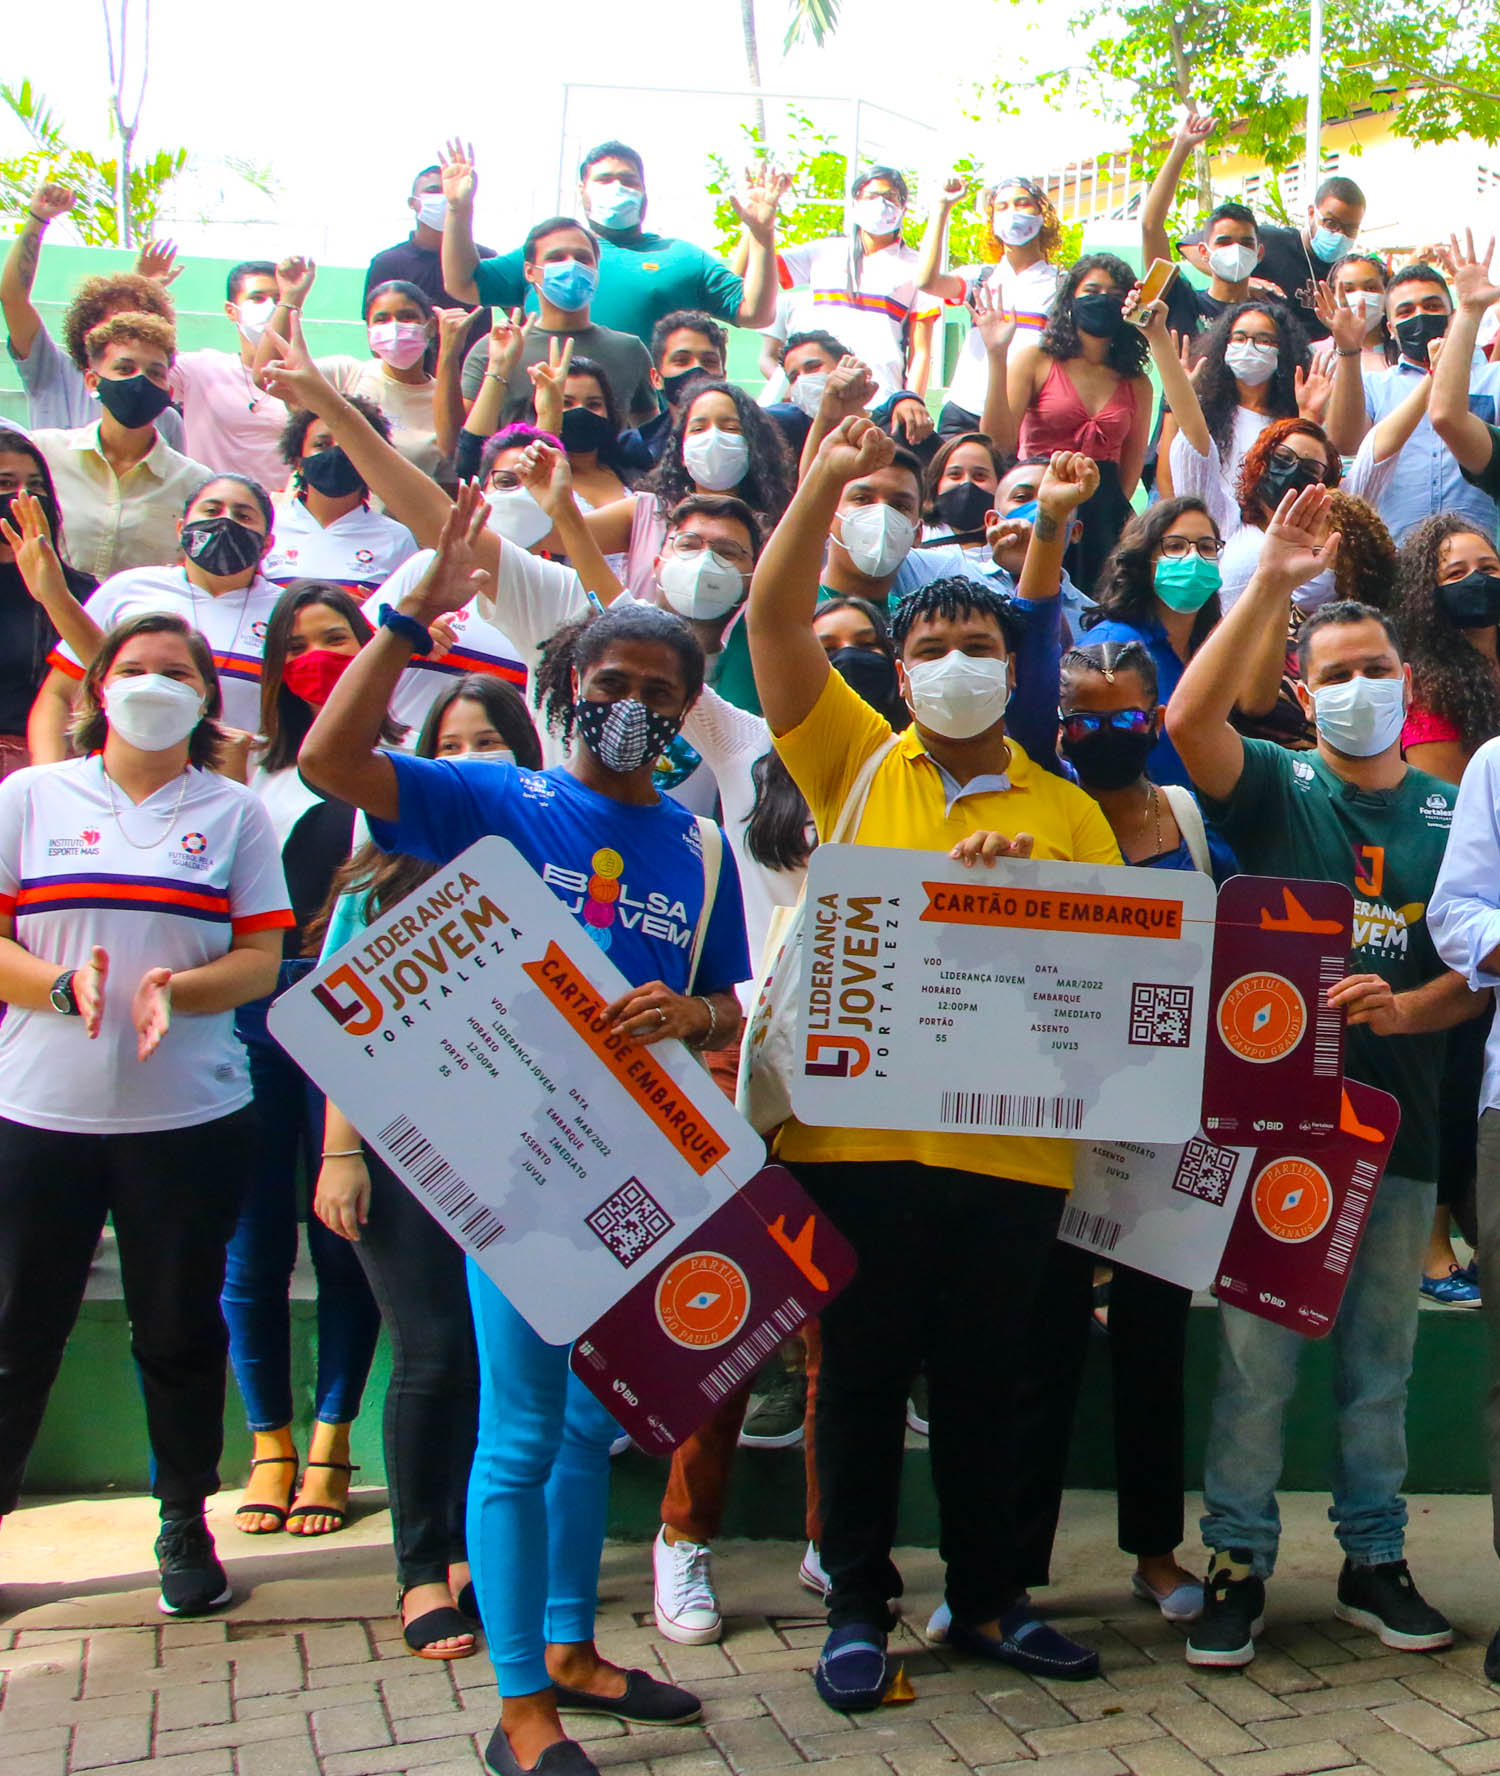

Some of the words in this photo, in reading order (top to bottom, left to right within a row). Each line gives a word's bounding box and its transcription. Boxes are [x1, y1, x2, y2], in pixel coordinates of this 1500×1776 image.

[1419, 807, 1453, 816] Fortalez
[48, 847, 80, 857] ESPORTE
[80, 847, 100, 856] MAIS
[49, 838, 84, 847] INSTITUTO
[934, 892, 1017, 916] CARTÃO
[1025, 901, 1052, 919] DE
[1058, 902, 1177, 929] EMBARQUE
[1354, 899, 1405, 926] ERANÇA
[352, 872, 480, 975] LIDERANÇA
[1353, 918, 1409, 951] VEM
[379, 895, 510, 1011] JOVEM
[808, 893, 842, 1029] LIDERANÇA
[924, 957, 942, 966] VOO
[1361, 946, 1405, 960] ALEZA
[838, 896, 882, 1032] JOVEM
[1035, 965, 1058, 974] DATA
[875, 898, 900, 1077] FORTALEZA
[940, 971, 992, 983] LIDERANÇA
[994, 975, 1025, 985] JOVEM
[1056, 978, 1104, 990] MAR/2022
[364, 927, 523, 1058] FORTALEZA
[921, 985, 961, 996] HORÁRIO
[1033, 992, 1081, 1004] EMBARQUE
[491, 997, 508, 1017] VOO
[937, 1001, 978, 1012] 12:00PM
[1054, 1009, 1102, 1020] IMEDIATO
[919, 1016, 954, 1027] PORTÃO
[1030, 1024, 1069, 1034] ASSENTO
[467, 1016, 500, 1053] HORÁRIO
[935, 1034, 947, 1043] 55
[1230, 1033, 1266, 1057] CAMPO
[1271, 1016, 1302, 1056] GRANDE
[439, 1039, 469, 1071] PORTÃO
[1051, 1041, 1079, 1051] JUV13
[466, 1042, 500, 1079] 12:00PM
[492, 1020, 532, 1067] LIDERANÇA
[530, 1064, 557, 1094] JOVEM
[541, 960, 606, 1034] CARTÃO
[604, 1033, 633, 1063] DE
[627, 1060, 719, 1165] EMBARQUE
[438, 1064, 452, 1077] 55
[568, 1088, 590, 1111] DATA
[546, 1108, 585, 1151] EMBARQUE
[1266, 1121, 1284, 1131] BID
[574, 1115, 612, 1158] MAR/2022
[519, 1131, 552, 1166] ASSENTO
[549, 1136, 587, 1180] IMEDIATO
[521, 1160, 547, 1186] JUV13
[1271, 1223, 1315, 1240] MANAUS
[1270, 1296, 1287, 1309] BID
[679, 1331, 719, 1345] PAULO
[623, 1388, 639, 1407] BID
